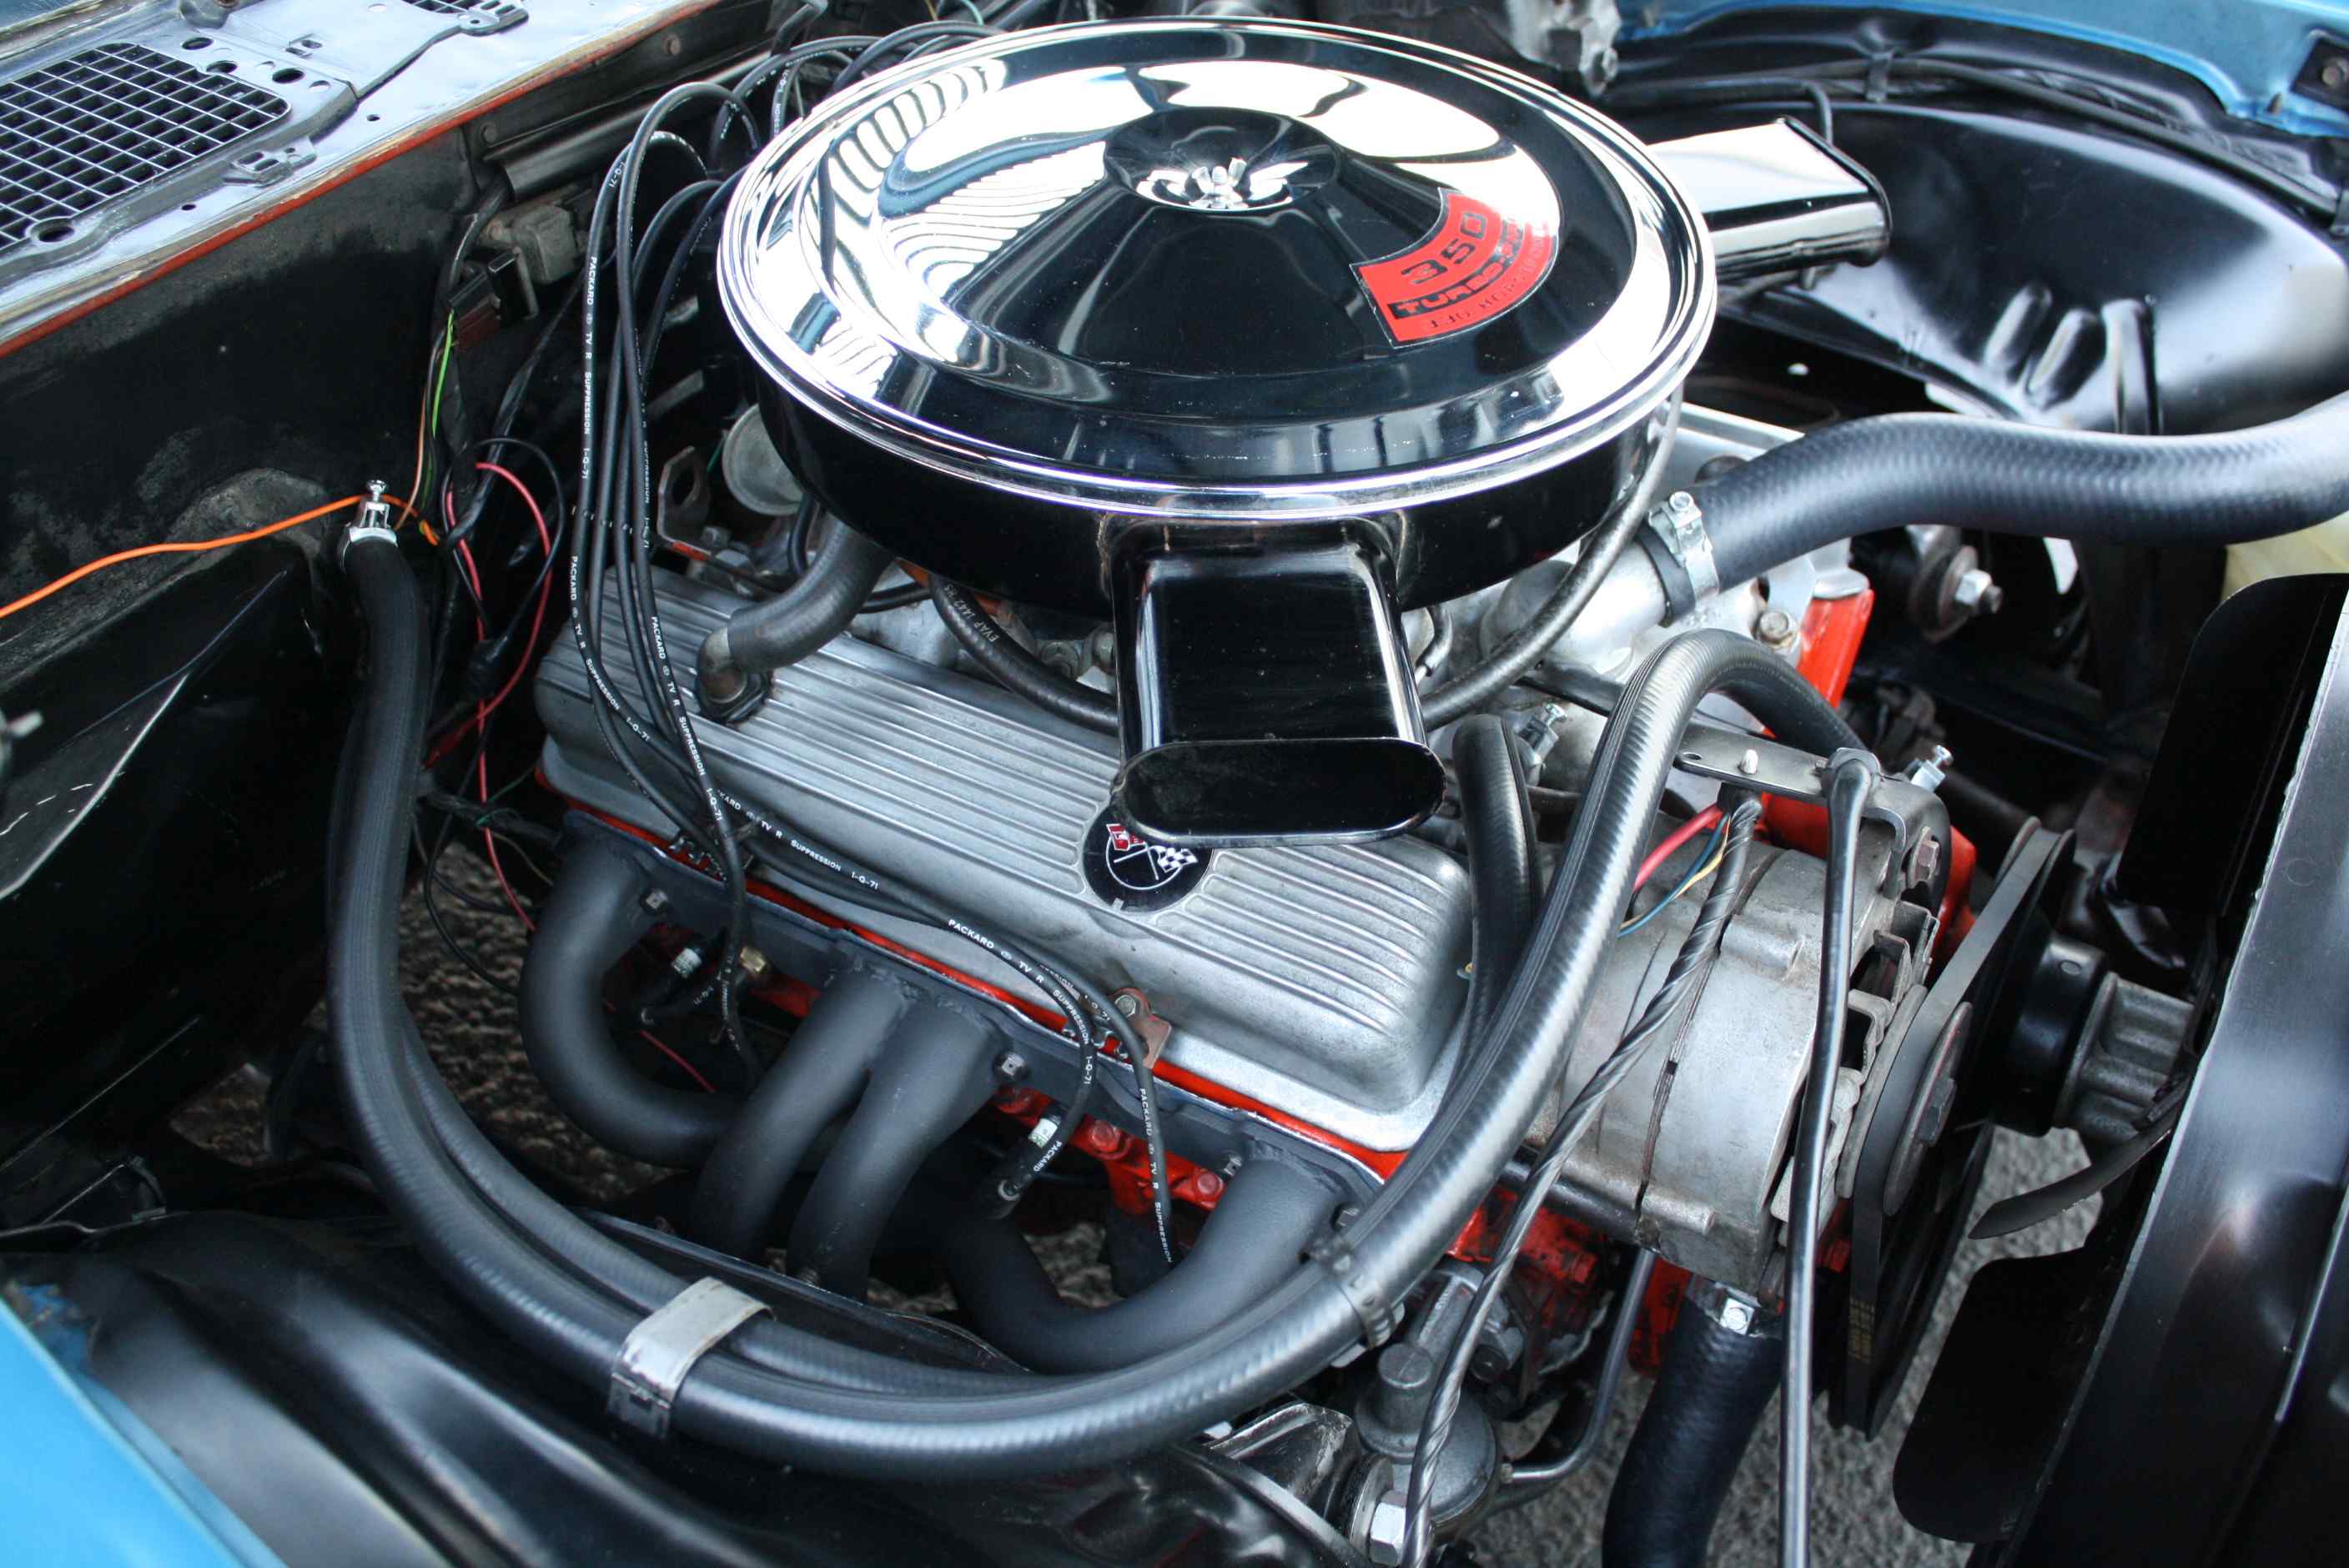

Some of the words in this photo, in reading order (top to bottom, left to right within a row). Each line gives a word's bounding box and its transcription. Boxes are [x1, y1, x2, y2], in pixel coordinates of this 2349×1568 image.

[586, 255, 597, 305] PACKARD
[1394, 214, 1521, 315] TURBO-FIR
[1401, 211, 1487, 284] 350
[586, 332, 593, 344] TV
[584, 371, 592, 435] SUPPRESSION
[570, 555, 578, 601] PACKARD
[575, 623, 583, 636] TV
[586, 658, 620, 711] SUPPRESSION
[651, 616, 666, 659] PACKARD
[667, 681, 677, 693] TV
[679, 716, 706, 776] SUPPRESSION
[717, 789, 742, 811] KARD
[761, 820, 772, 831] TV
[776, 830, 783, 839] R
[790, 839, 842, 872] SUPPRESSION
[948, 919, 994, 949] PACKARD
[1019, 960, 1033, 973] TV
[1035, 974, 1044, 983] R
[1053, 988, 1089, 1045] SUPPRESSION
[1033, 1140, 1063, 1172] PACKARD
[1139, 1088, 1153, 1136] PACKARD
[1150, 1162, 1158, 1175] TV
